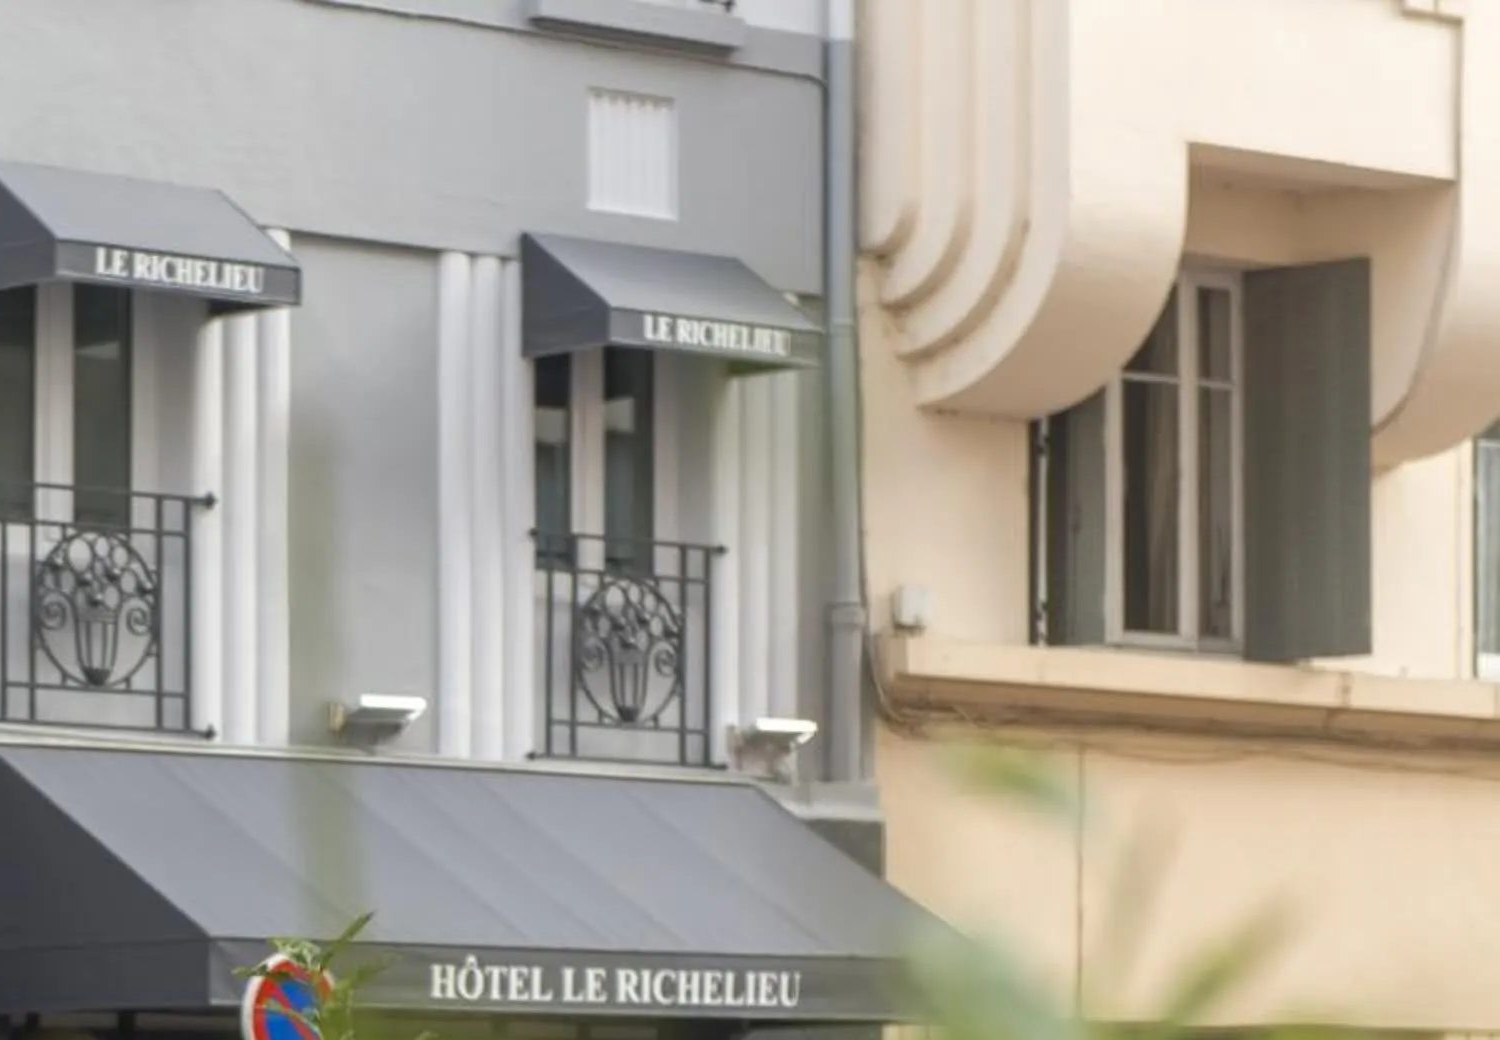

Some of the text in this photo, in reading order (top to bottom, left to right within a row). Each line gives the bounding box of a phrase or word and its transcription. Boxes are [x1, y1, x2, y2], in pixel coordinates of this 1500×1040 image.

[95, 246, 264, 293] LE RICHELIEU
[643, 314, 791, 356] LE RICHELIEU
[430, 953, 802, 1008] HÔTEL LE RICHELIEU
